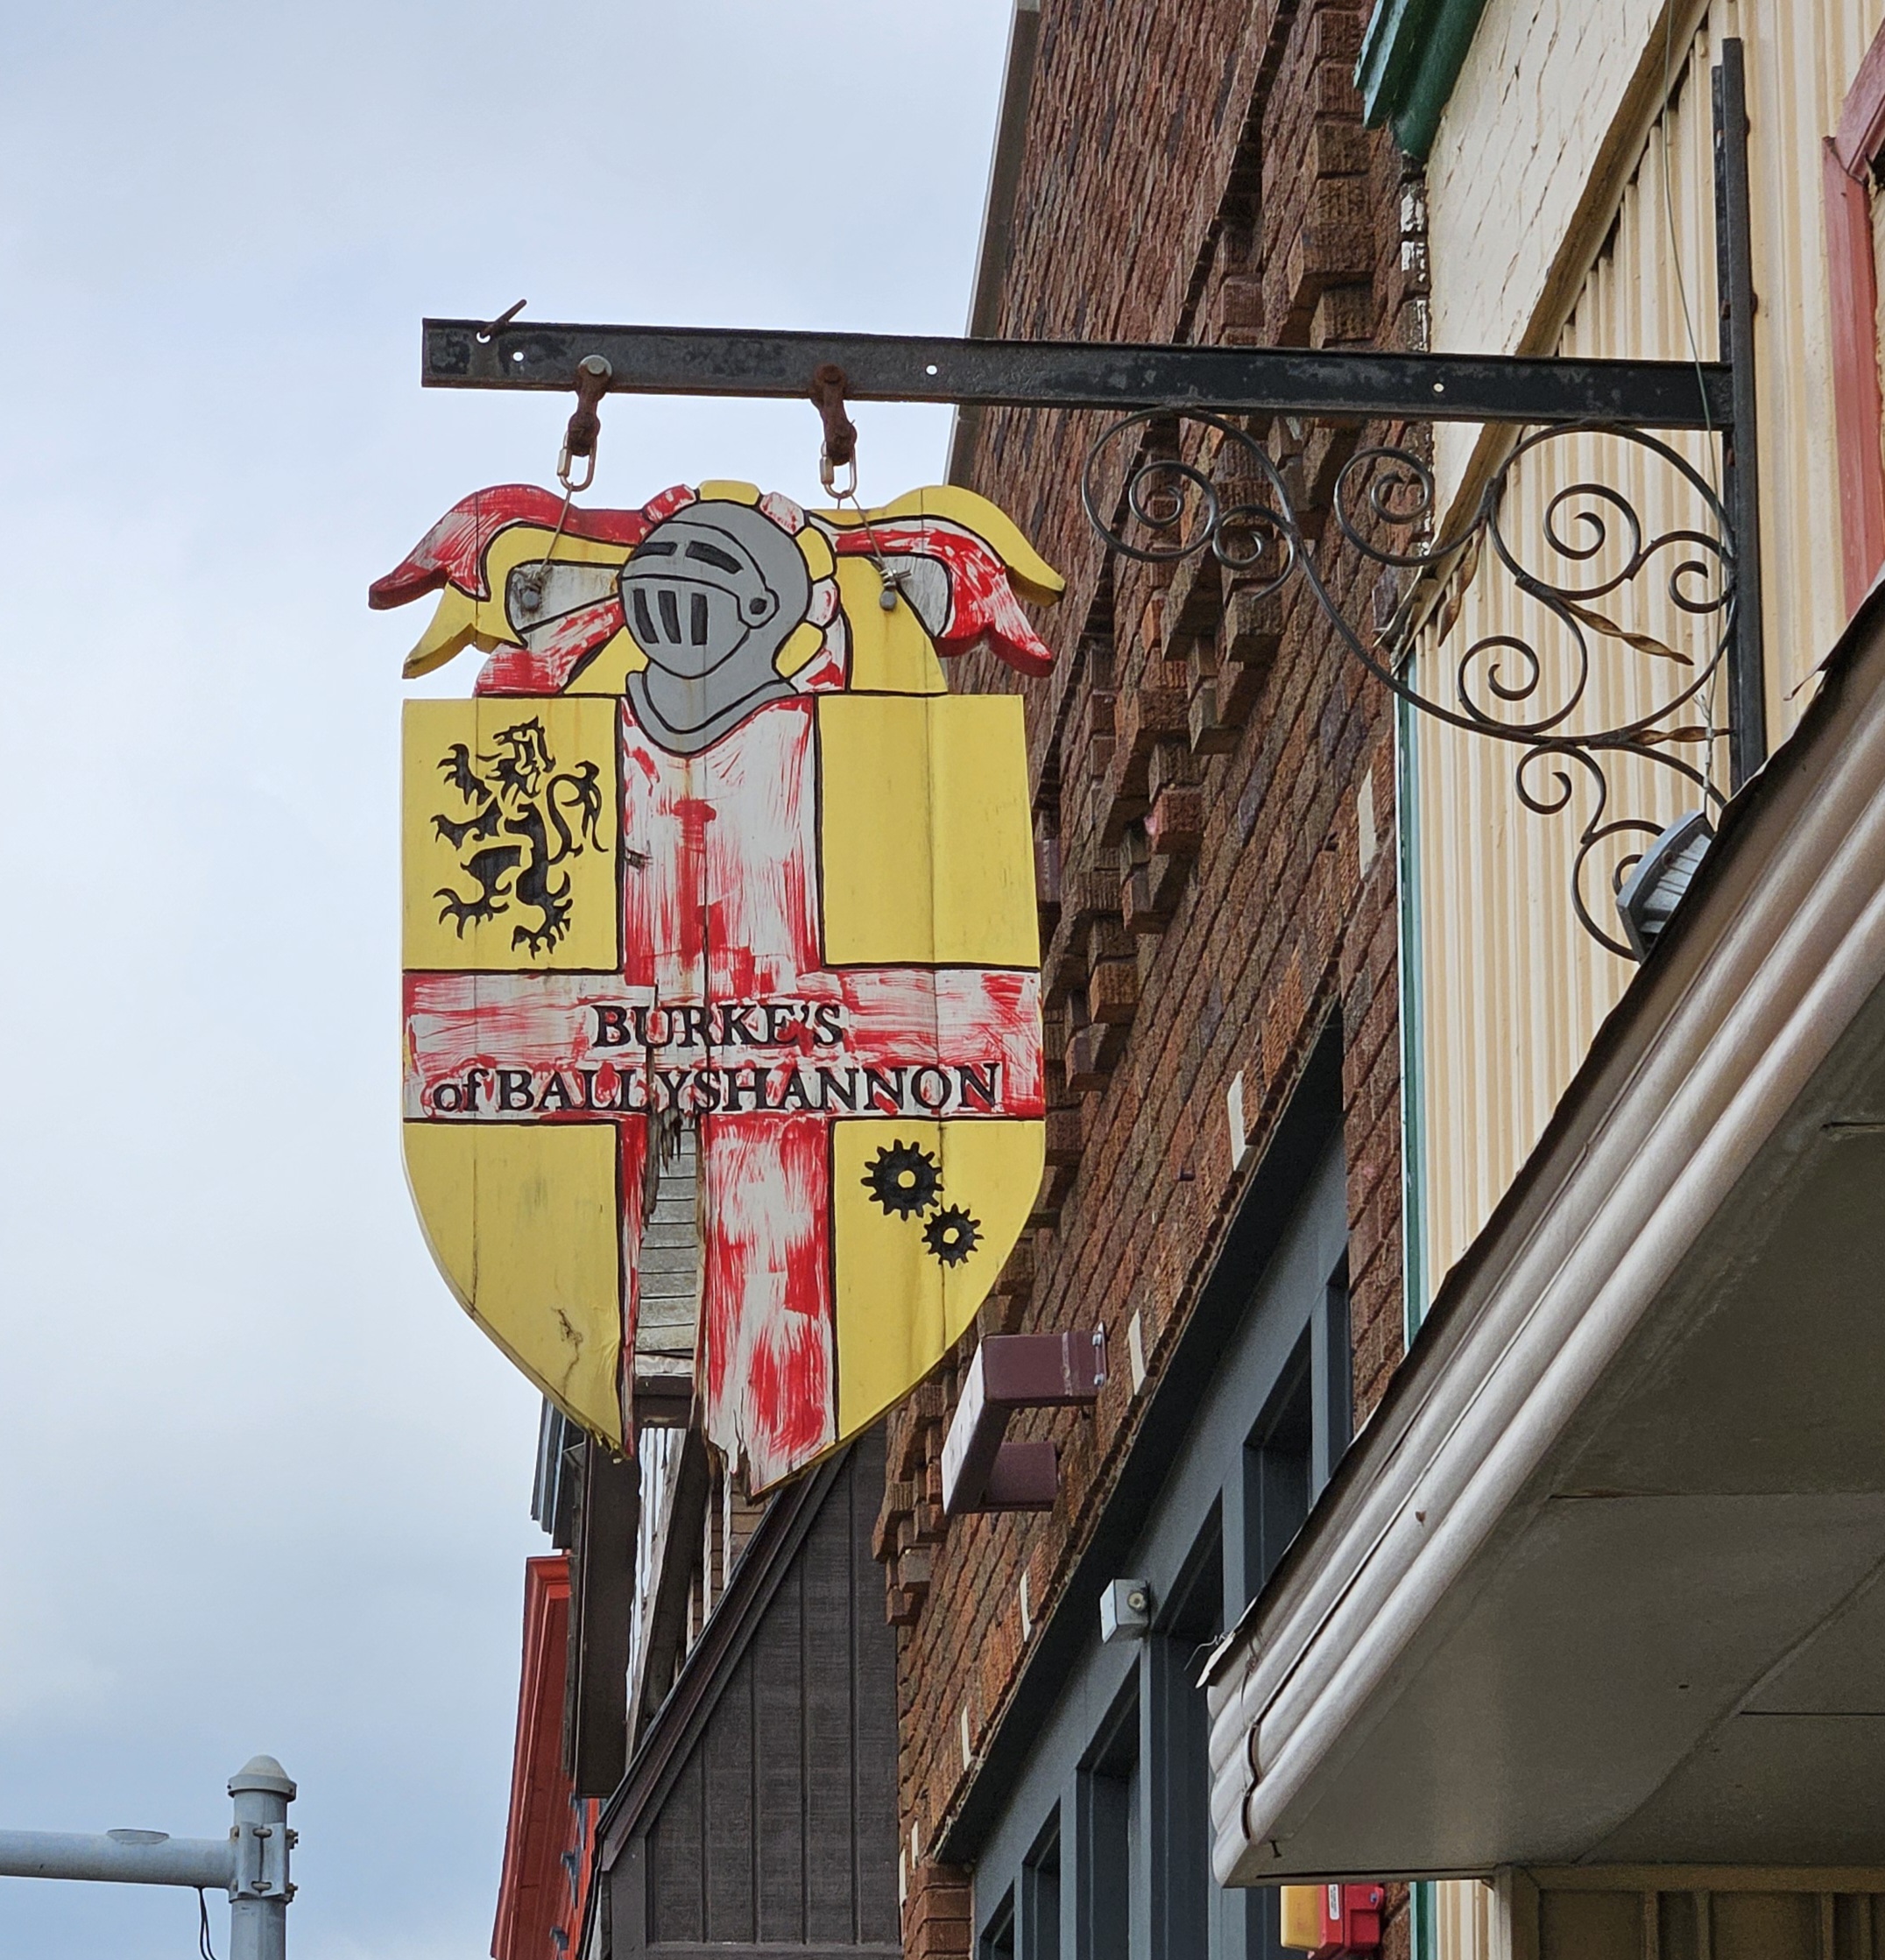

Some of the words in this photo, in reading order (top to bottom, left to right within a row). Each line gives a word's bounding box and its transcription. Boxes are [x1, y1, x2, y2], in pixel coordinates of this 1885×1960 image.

[592, 1004, 844, 1047] BURKE'S
[433, 1068, 489, 1112] of
[495, 1062, 1000, 1112] BALLYSHANNON
